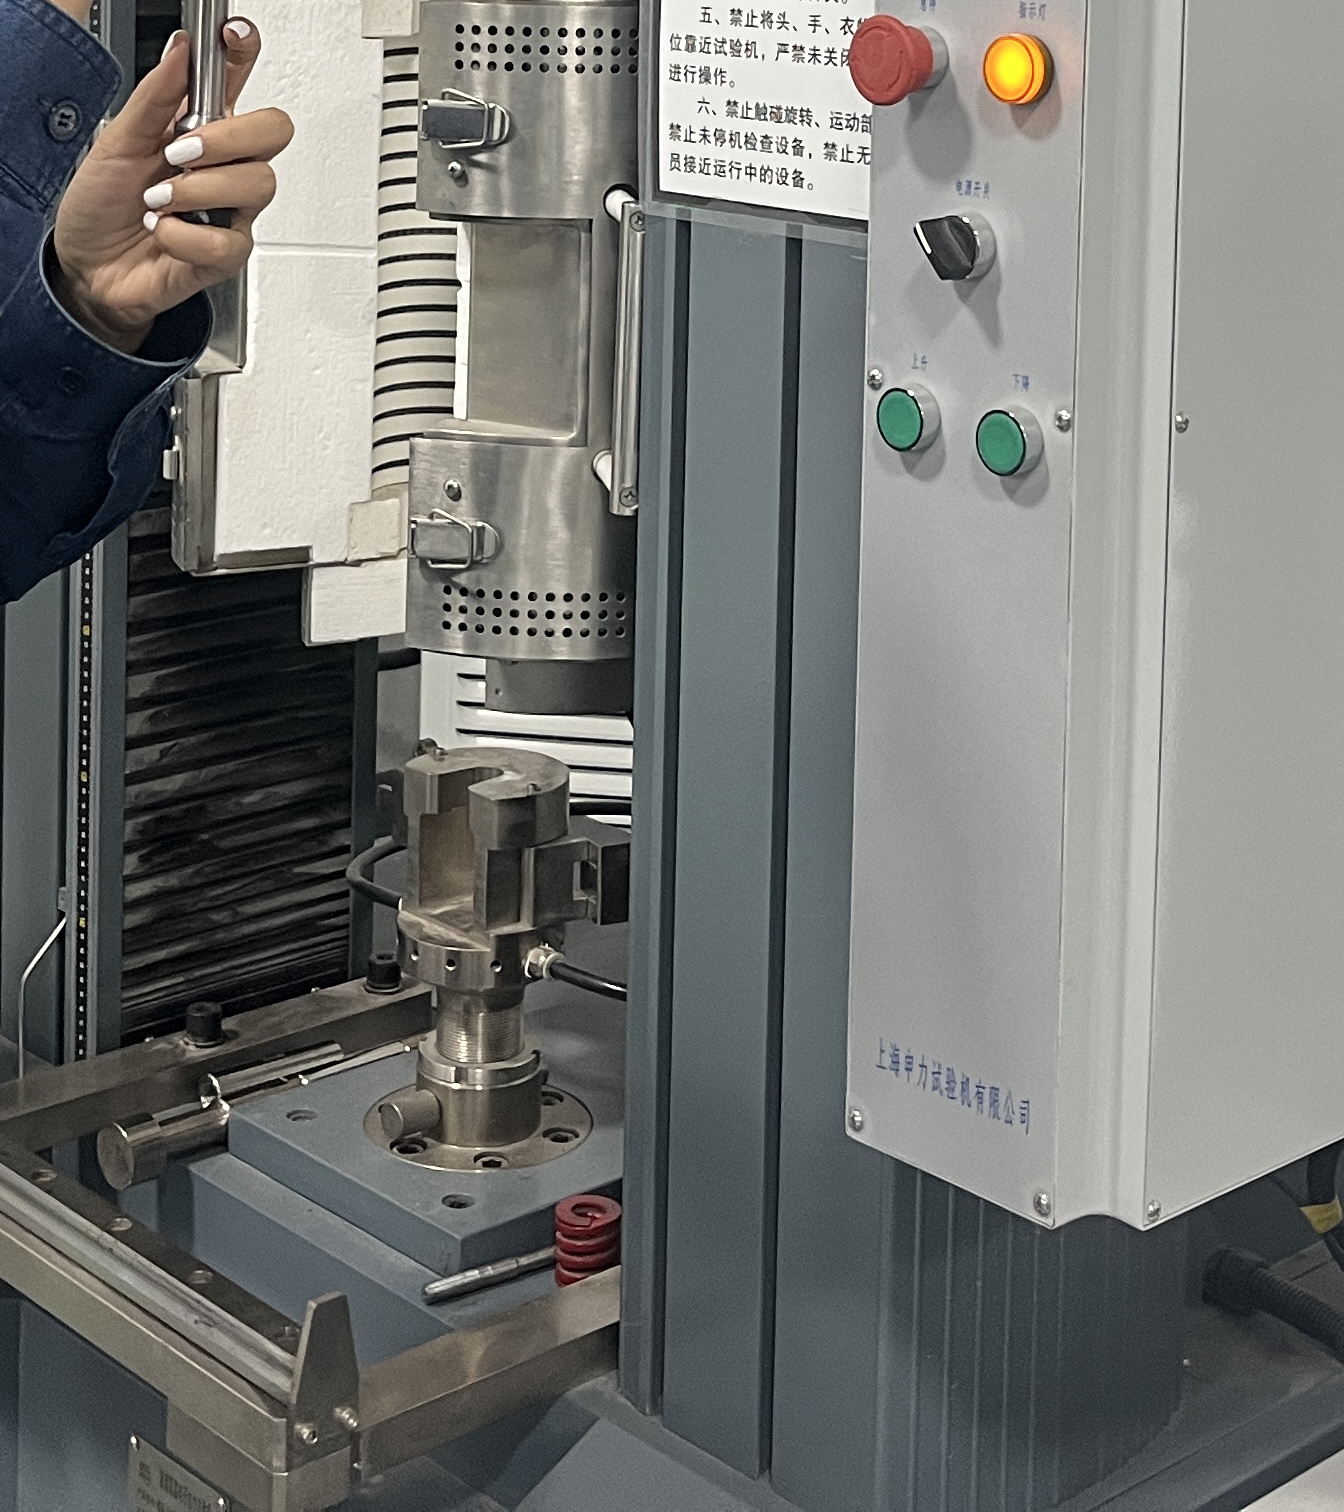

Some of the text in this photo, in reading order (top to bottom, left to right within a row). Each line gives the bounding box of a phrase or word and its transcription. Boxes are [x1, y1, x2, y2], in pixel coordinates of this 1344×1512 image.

[668, 63, 735, 89] 进行操作。
[669, 152, 814, 191] 员接近运行中的设备。
[874, 1037, 1031, 1136] 上海申力试验机有限公司
